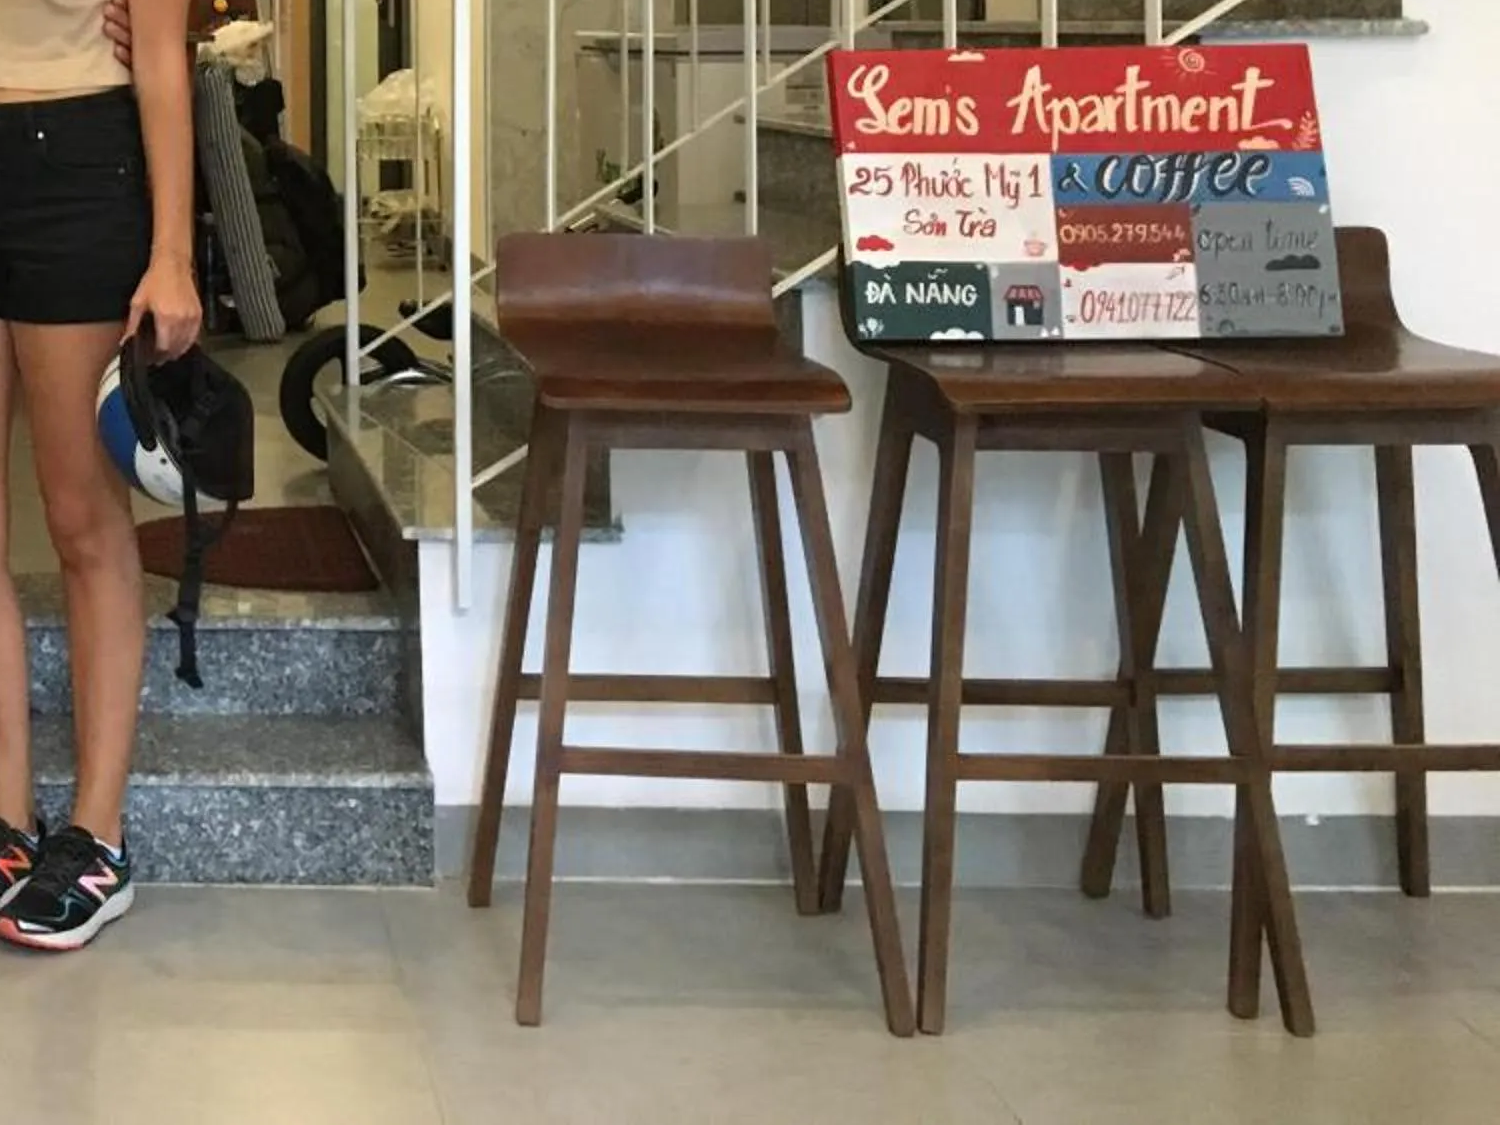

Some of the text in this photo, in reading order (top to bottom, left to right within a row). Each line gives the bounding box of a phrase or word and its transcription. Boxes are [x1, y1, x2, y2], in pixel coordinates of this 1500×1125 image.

[1006, 63, 1293, 153] Apartment
[849, 166, 893, 197] 25
[1027, 162, 1043, 198] 1
[956, 207, 998, 238] Trà
[864, 273, 897, 305] ĐÀ
